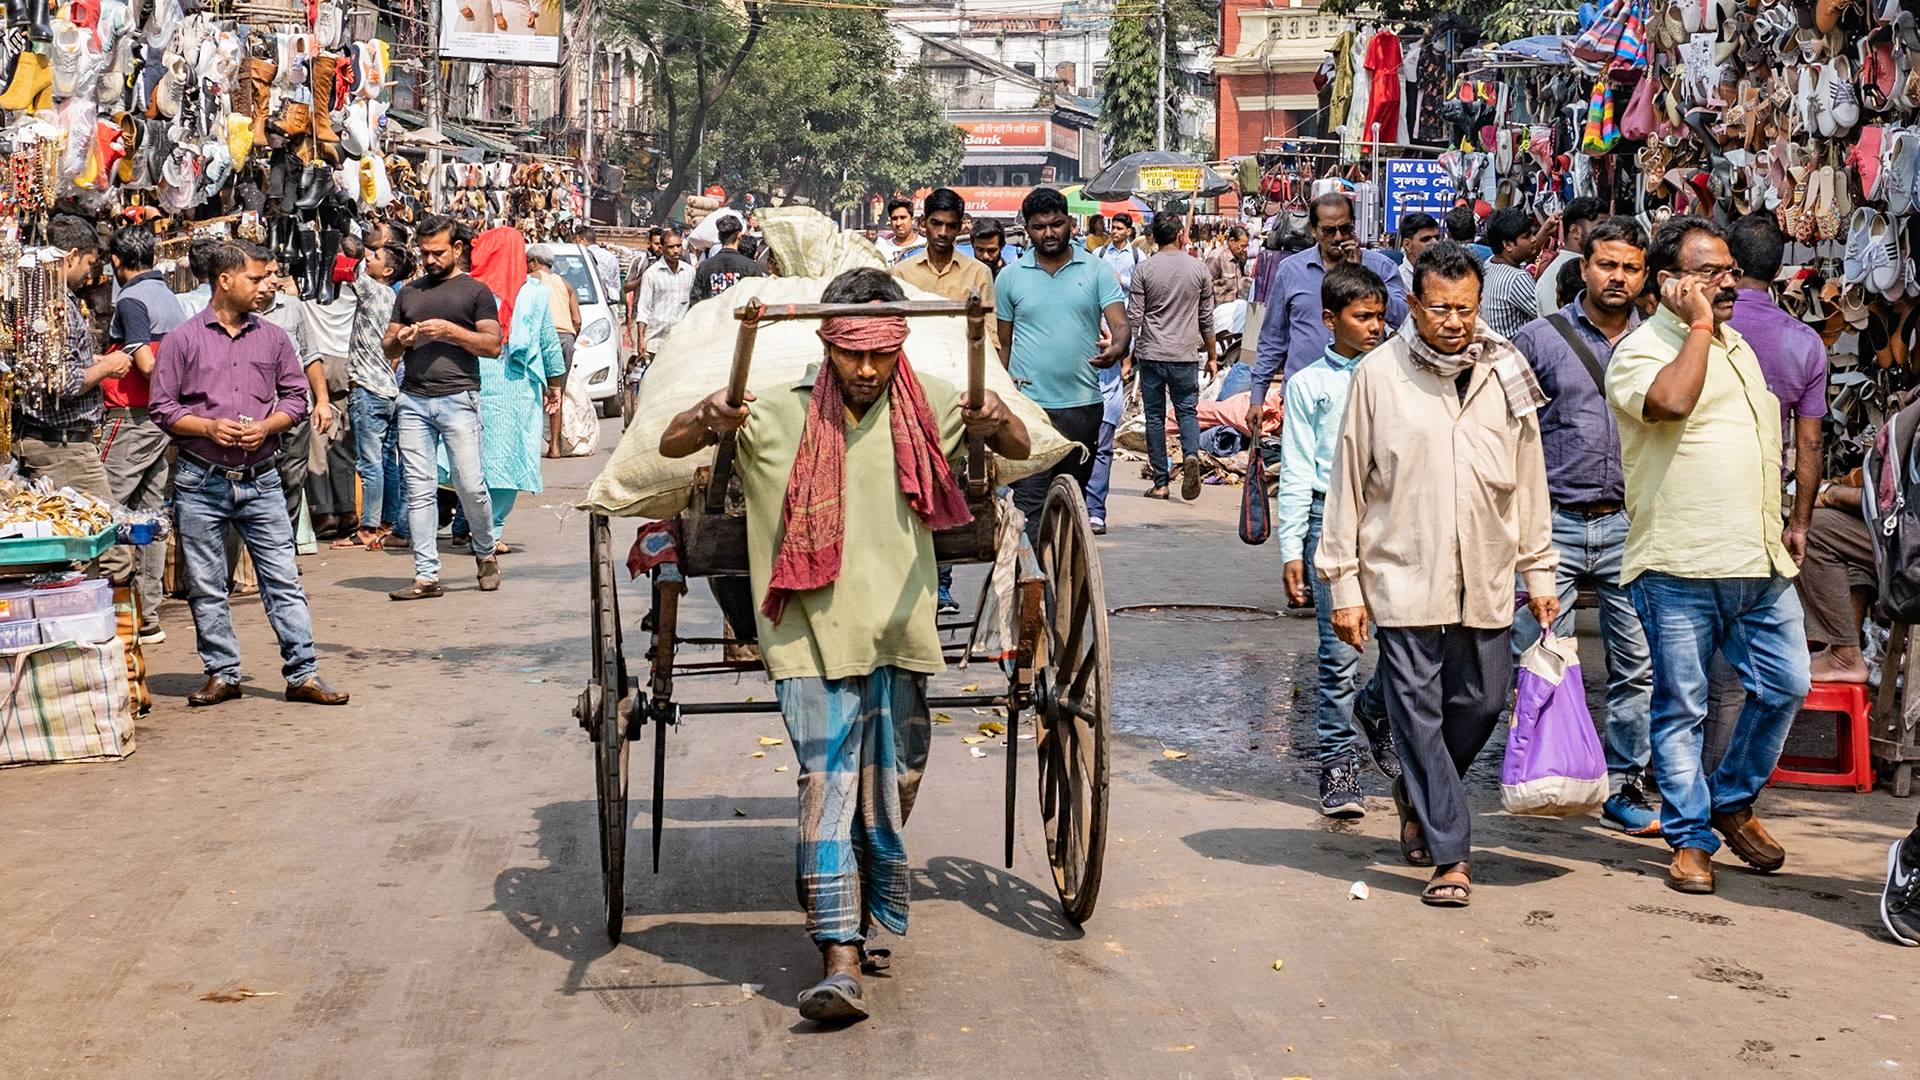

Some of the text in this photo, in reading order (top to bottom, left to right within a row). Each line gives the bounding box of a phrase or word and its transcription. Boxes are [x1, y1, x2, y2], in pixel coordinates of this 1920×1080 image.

[965, 134, 1001, 144] Bank
[1393, 163, 1446, 173] PAY & US
[965, 200, 988, 209] ank
